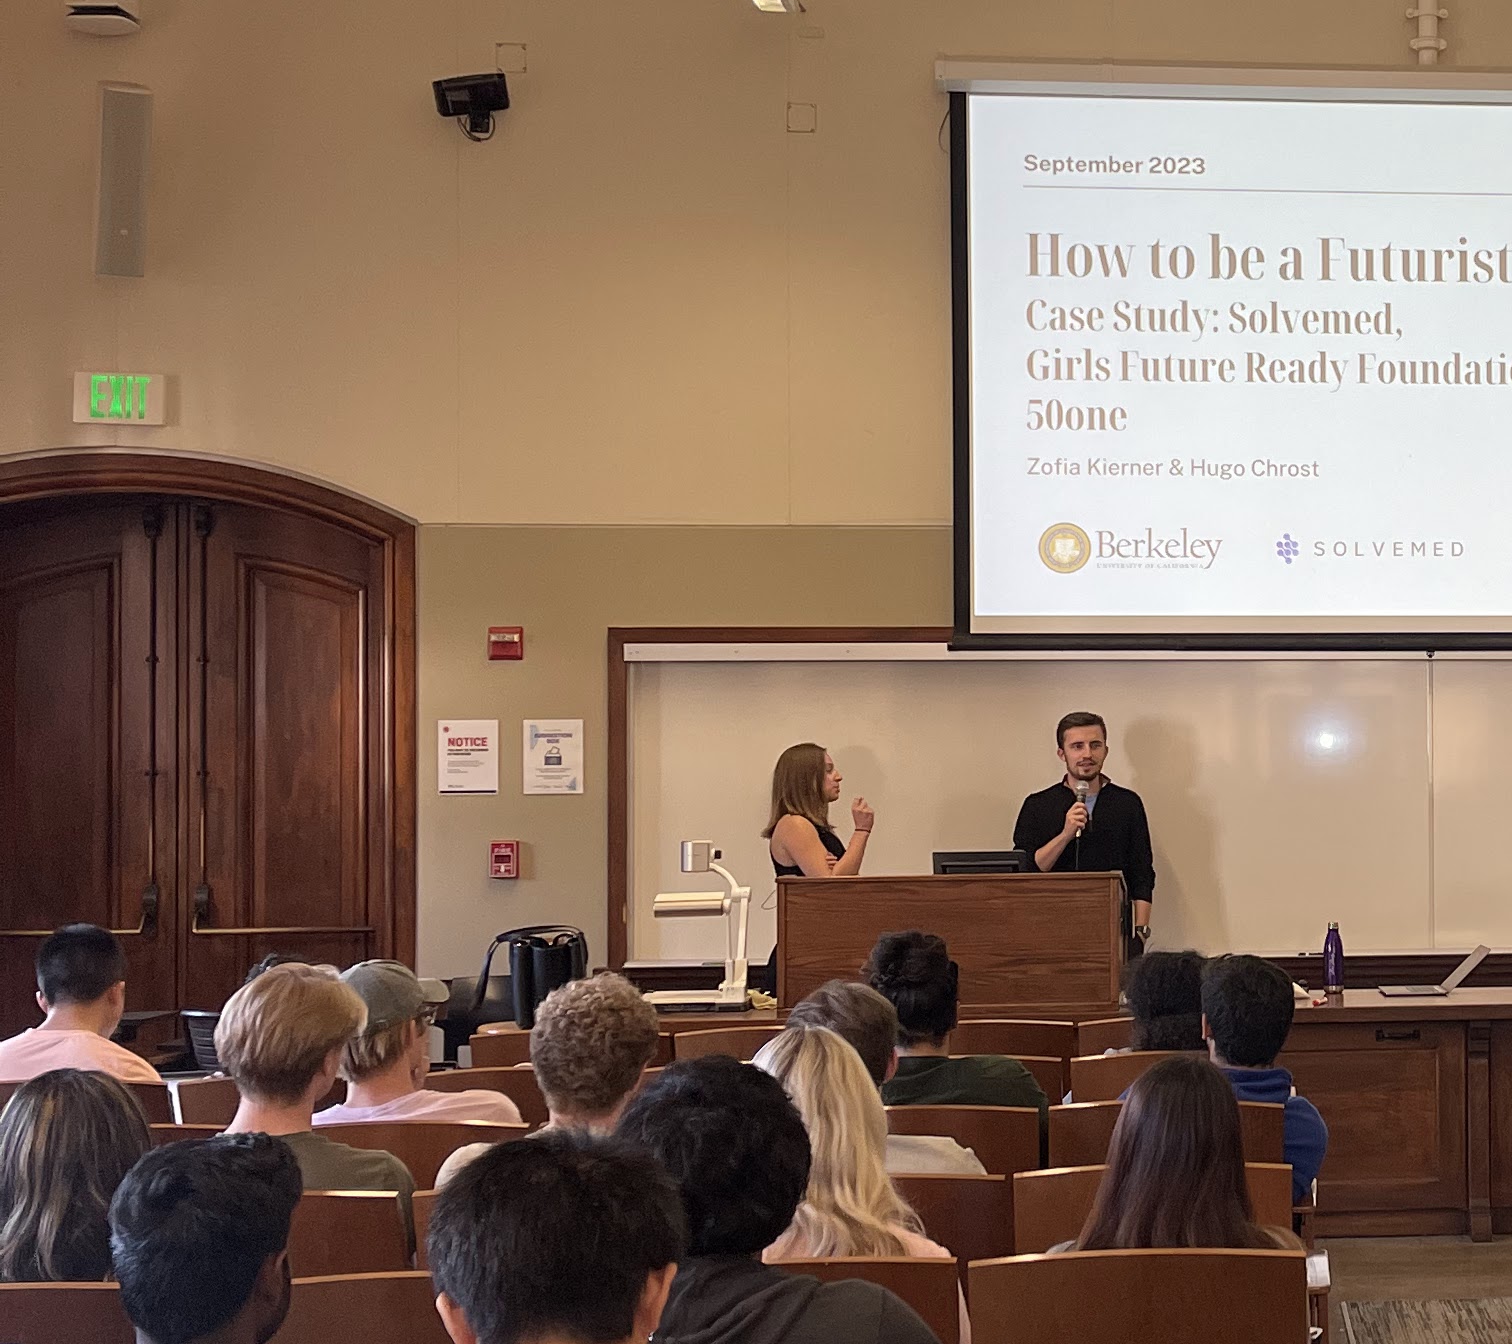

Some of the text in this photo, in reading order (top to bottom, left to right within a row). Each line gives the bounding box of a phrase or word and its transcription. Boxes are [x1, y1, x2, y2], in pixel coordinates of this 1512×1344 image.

[1023, 153, 1206, 176] September 2023
[1025, 232, 1137, 279] How
[1146, 238, 1196, 280] to
[1207, 232, 1266, 281] be
[1278, 246, 1305, 281] a
[1026, 298, 1403, 343] Case Study: Solvemed,
[1026, 347, 1112, 382] Girls
[1118, 350, 1236, 384] Future
[1243, 351, 1349, 394] Ready
[90, 374, 152, 419] EXIT
[1026, 398, 1128, 432] 50one
[1026, 457, 1320, 481] Zofia Kierner & Hugo Chrost
[1095, 527, 1224, 570] Berkeley
[1313, 540, 1464, 558] SOLVEMED
[447, 737, 488, 747] NOTICE
